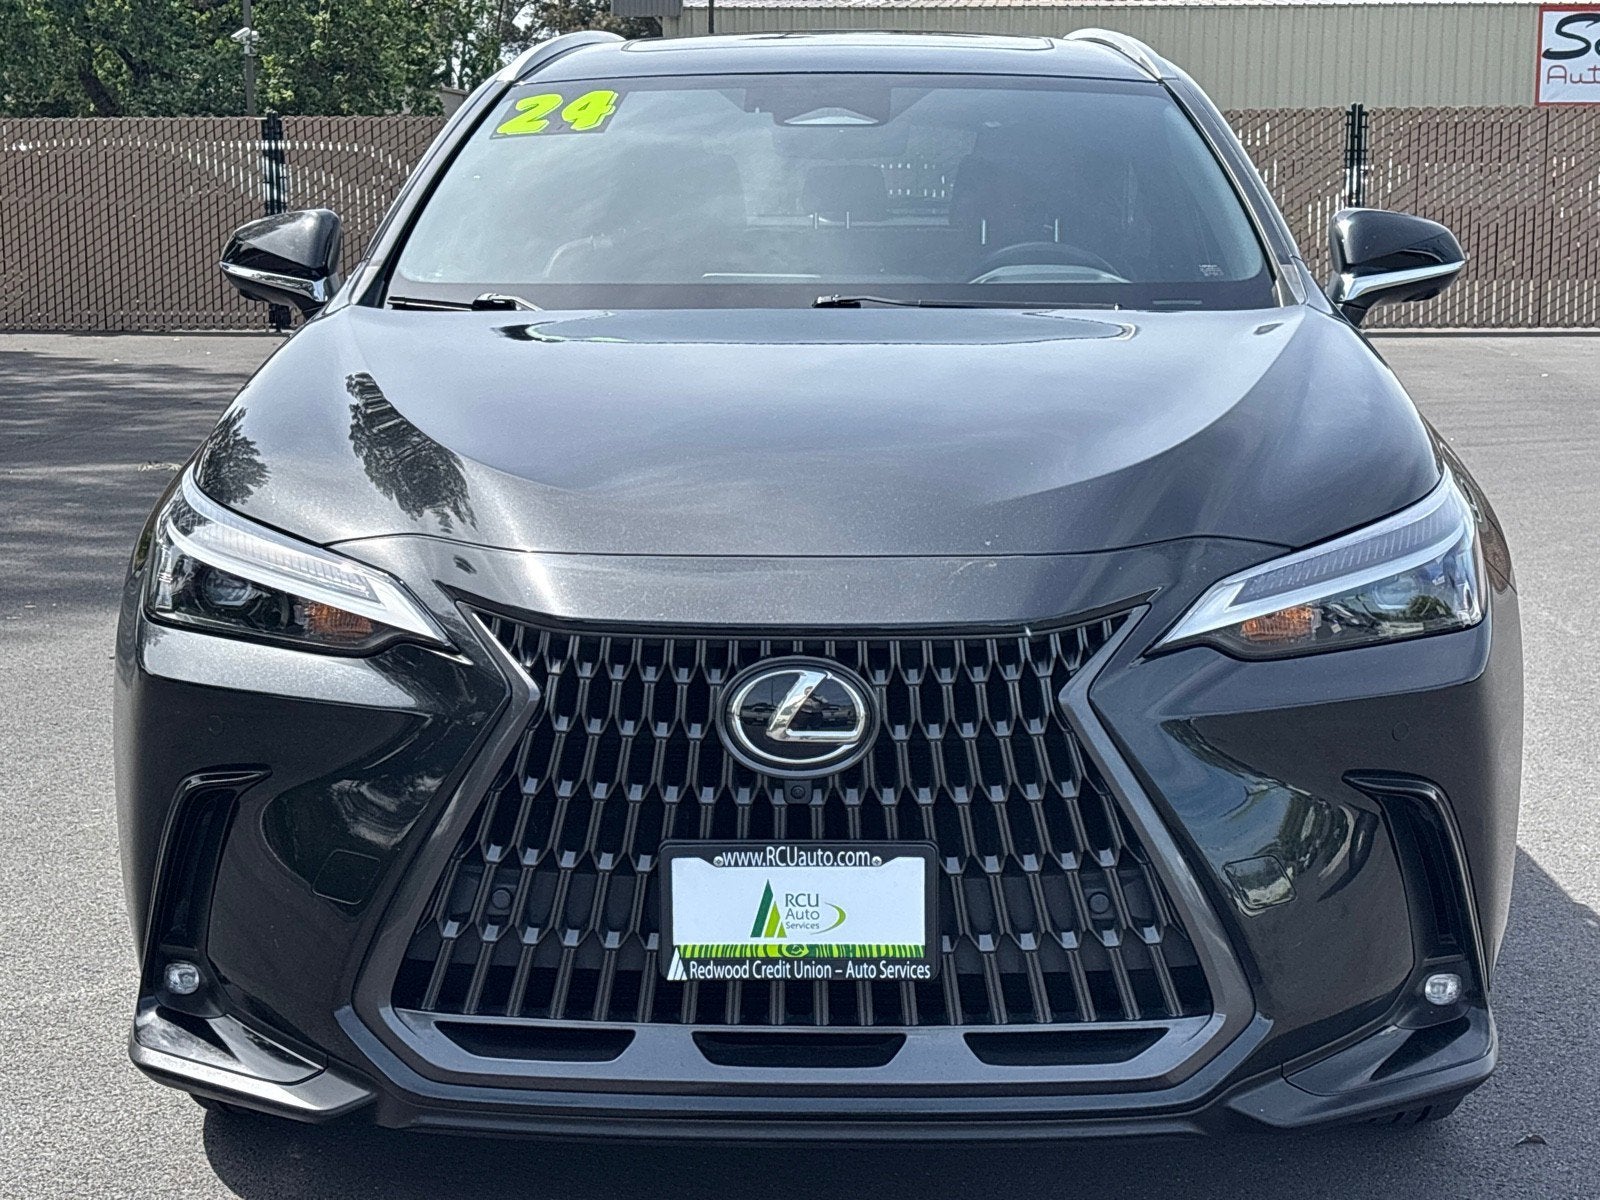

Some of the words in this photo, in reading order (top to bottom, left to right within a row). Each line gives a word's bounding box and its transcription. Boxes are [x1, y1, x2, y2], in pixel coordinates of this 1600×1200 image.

[1542, 12, 1600, 60] S
[496, 90, 619, 135] 24
[722, 846, 871, 867] www.RCUauto.com
[785, 893, 820, 908] RCU
[785, 909, 820, 921] Auto
[785, 921, 820, 930] Services
[689, 960, 750, 979] Redwood
[752, 960, 792, 979] Credit
[793, 960, 833, 979] Union
[845, 960, 877, 979] Auto
[879, 960, 931, 980] Services
